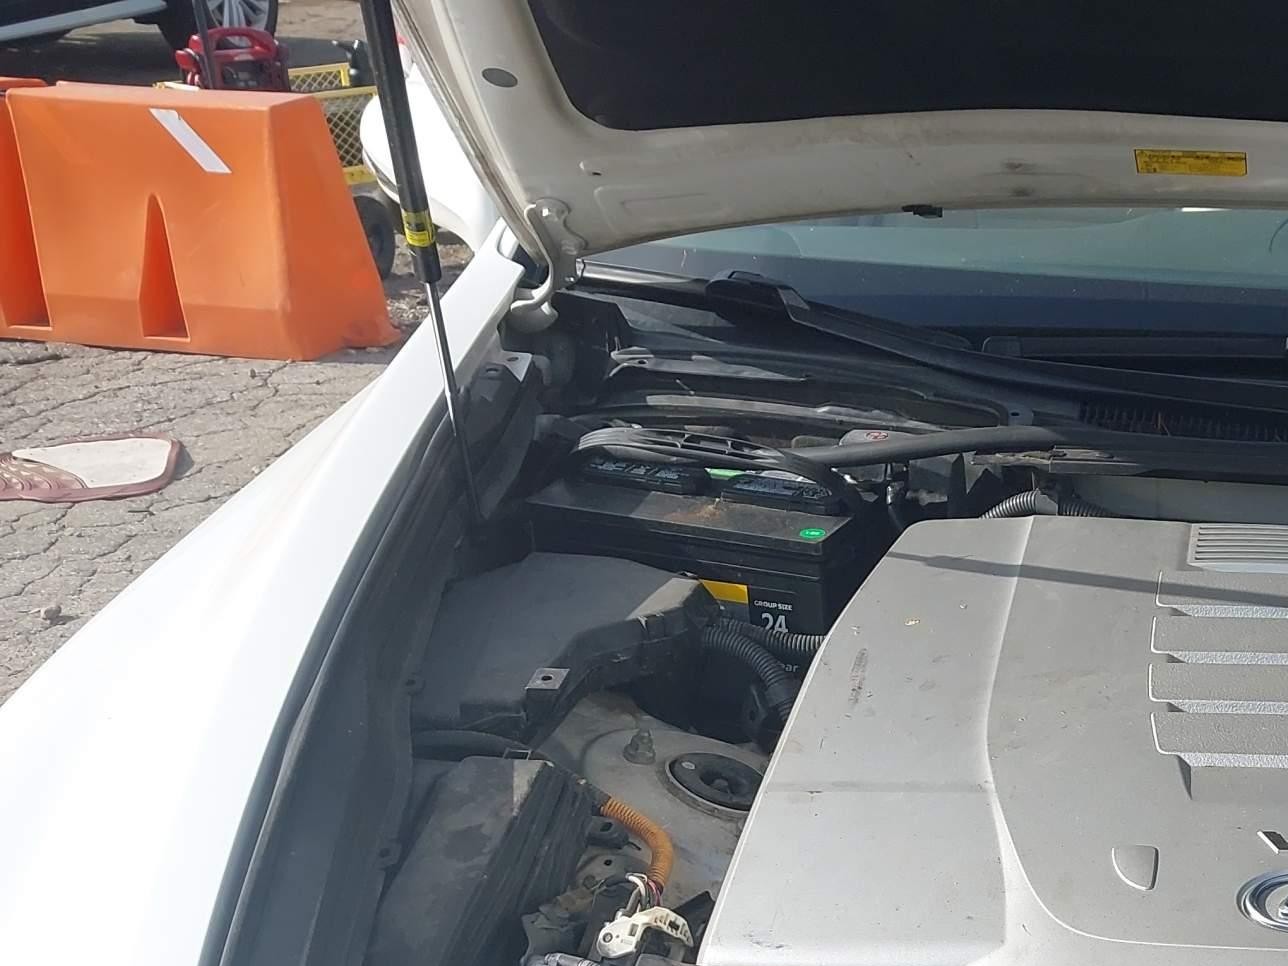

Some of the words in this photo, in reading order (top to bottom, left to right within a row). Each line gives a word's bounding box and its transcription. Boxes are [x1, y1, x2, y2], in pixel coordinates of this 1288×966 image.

[754, 600, 777, 609] GROUP
[778, 603, 793, 611] SIZE
[761, 612, 789, 633] 24
